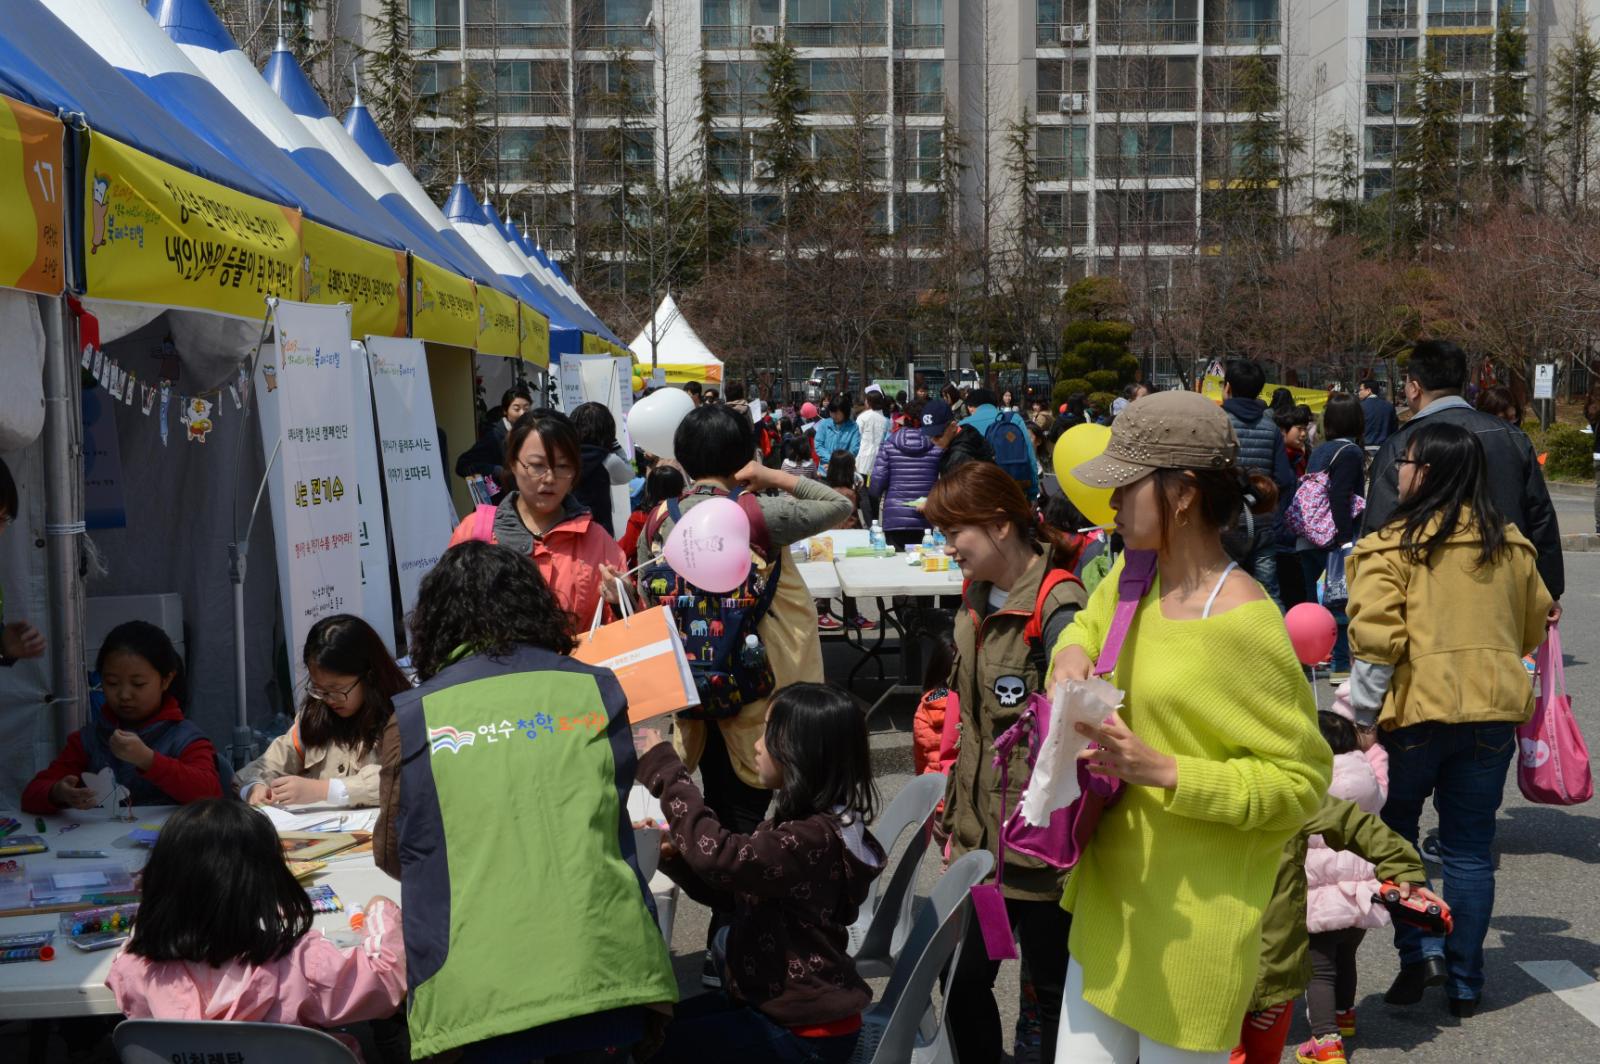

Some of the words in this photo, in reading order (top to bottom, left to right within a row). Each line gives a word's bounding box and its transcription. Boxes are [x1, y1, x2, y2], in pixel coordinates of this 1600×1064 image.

[33, 160, 55, 203] 17
[305, 427, 321, 442] 청소년
[322, 425, 348, 440] 캠페인단
[398, 438, 431, 453] 들려주시는
[404, 465, 431, 481] 보따리
